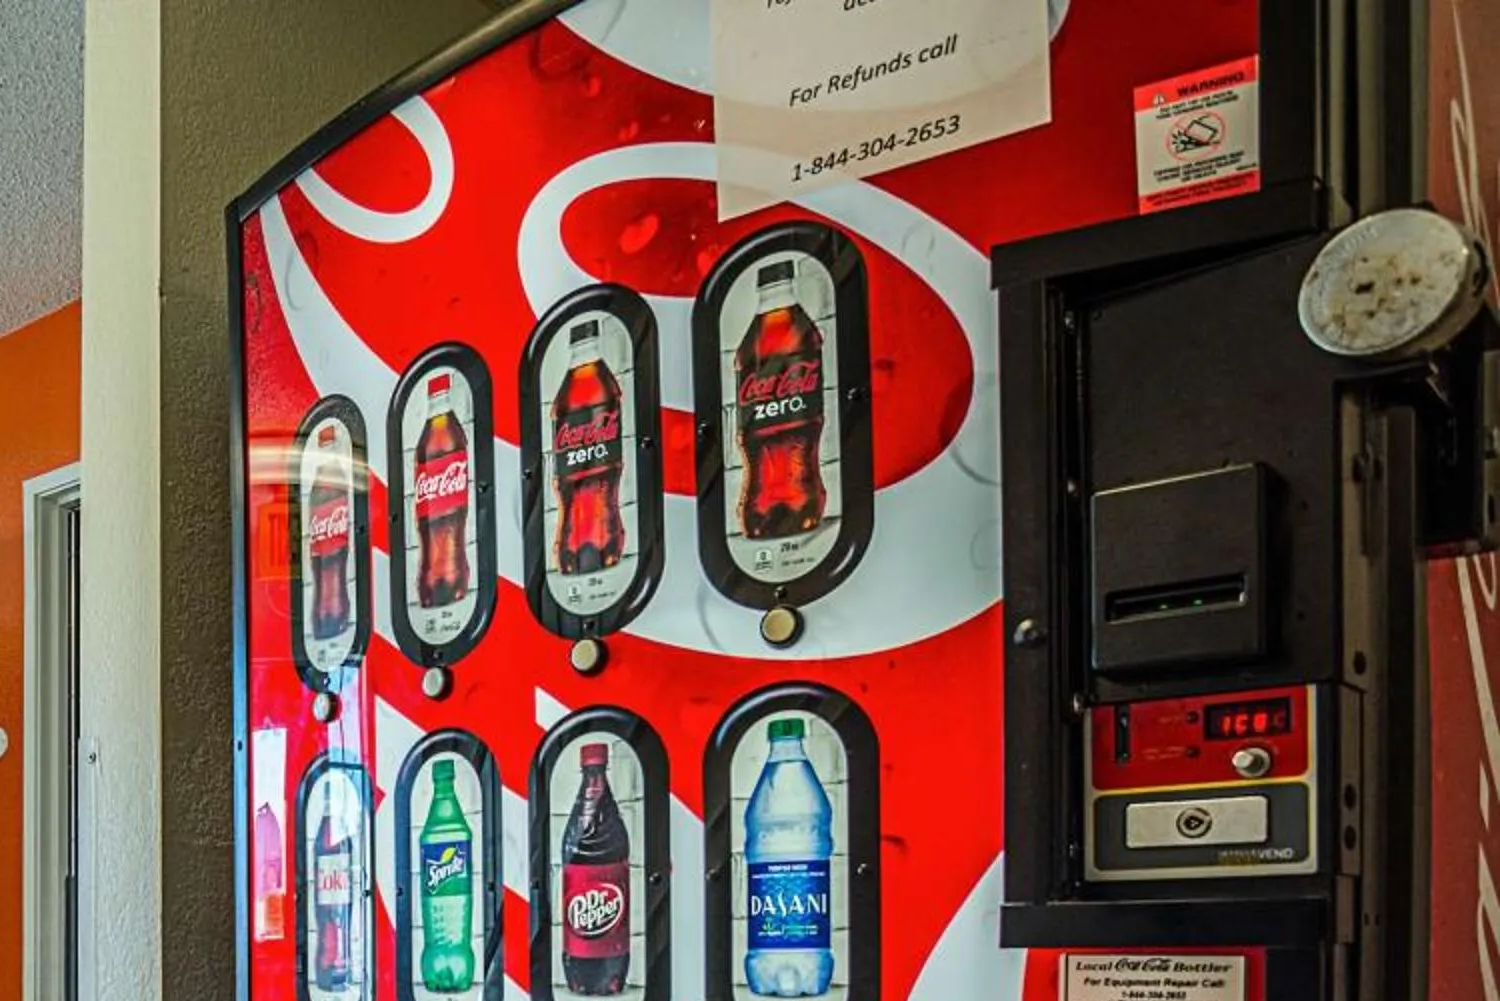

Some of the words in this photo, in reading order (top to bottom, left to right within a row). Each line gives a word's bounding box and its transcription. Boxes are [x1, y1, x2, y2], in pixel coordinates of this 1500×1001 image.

[788, 83, 823, 108] For
[827, 51, 913, 94] Refunds
[918, 33, 959, 63] call
[1177, 72, 1245, 97] WARNING
[791, 114, 961, 182] 1-844-304-2653
[428, 855, 465, 887] Sprite
[585, 889, 609, 909] Dr
[751, 892, 827, 918] DASANI
[573, 895, 620, 930] Pepper
[1076, 961, 1112, 972] Local
[1173, 962, 1232, 973] Bottler
[1083, 977, 1102, 987] For
[1103, 977, 1160, 988] Equipment
[1163, 977, 1198, 988] Repair
